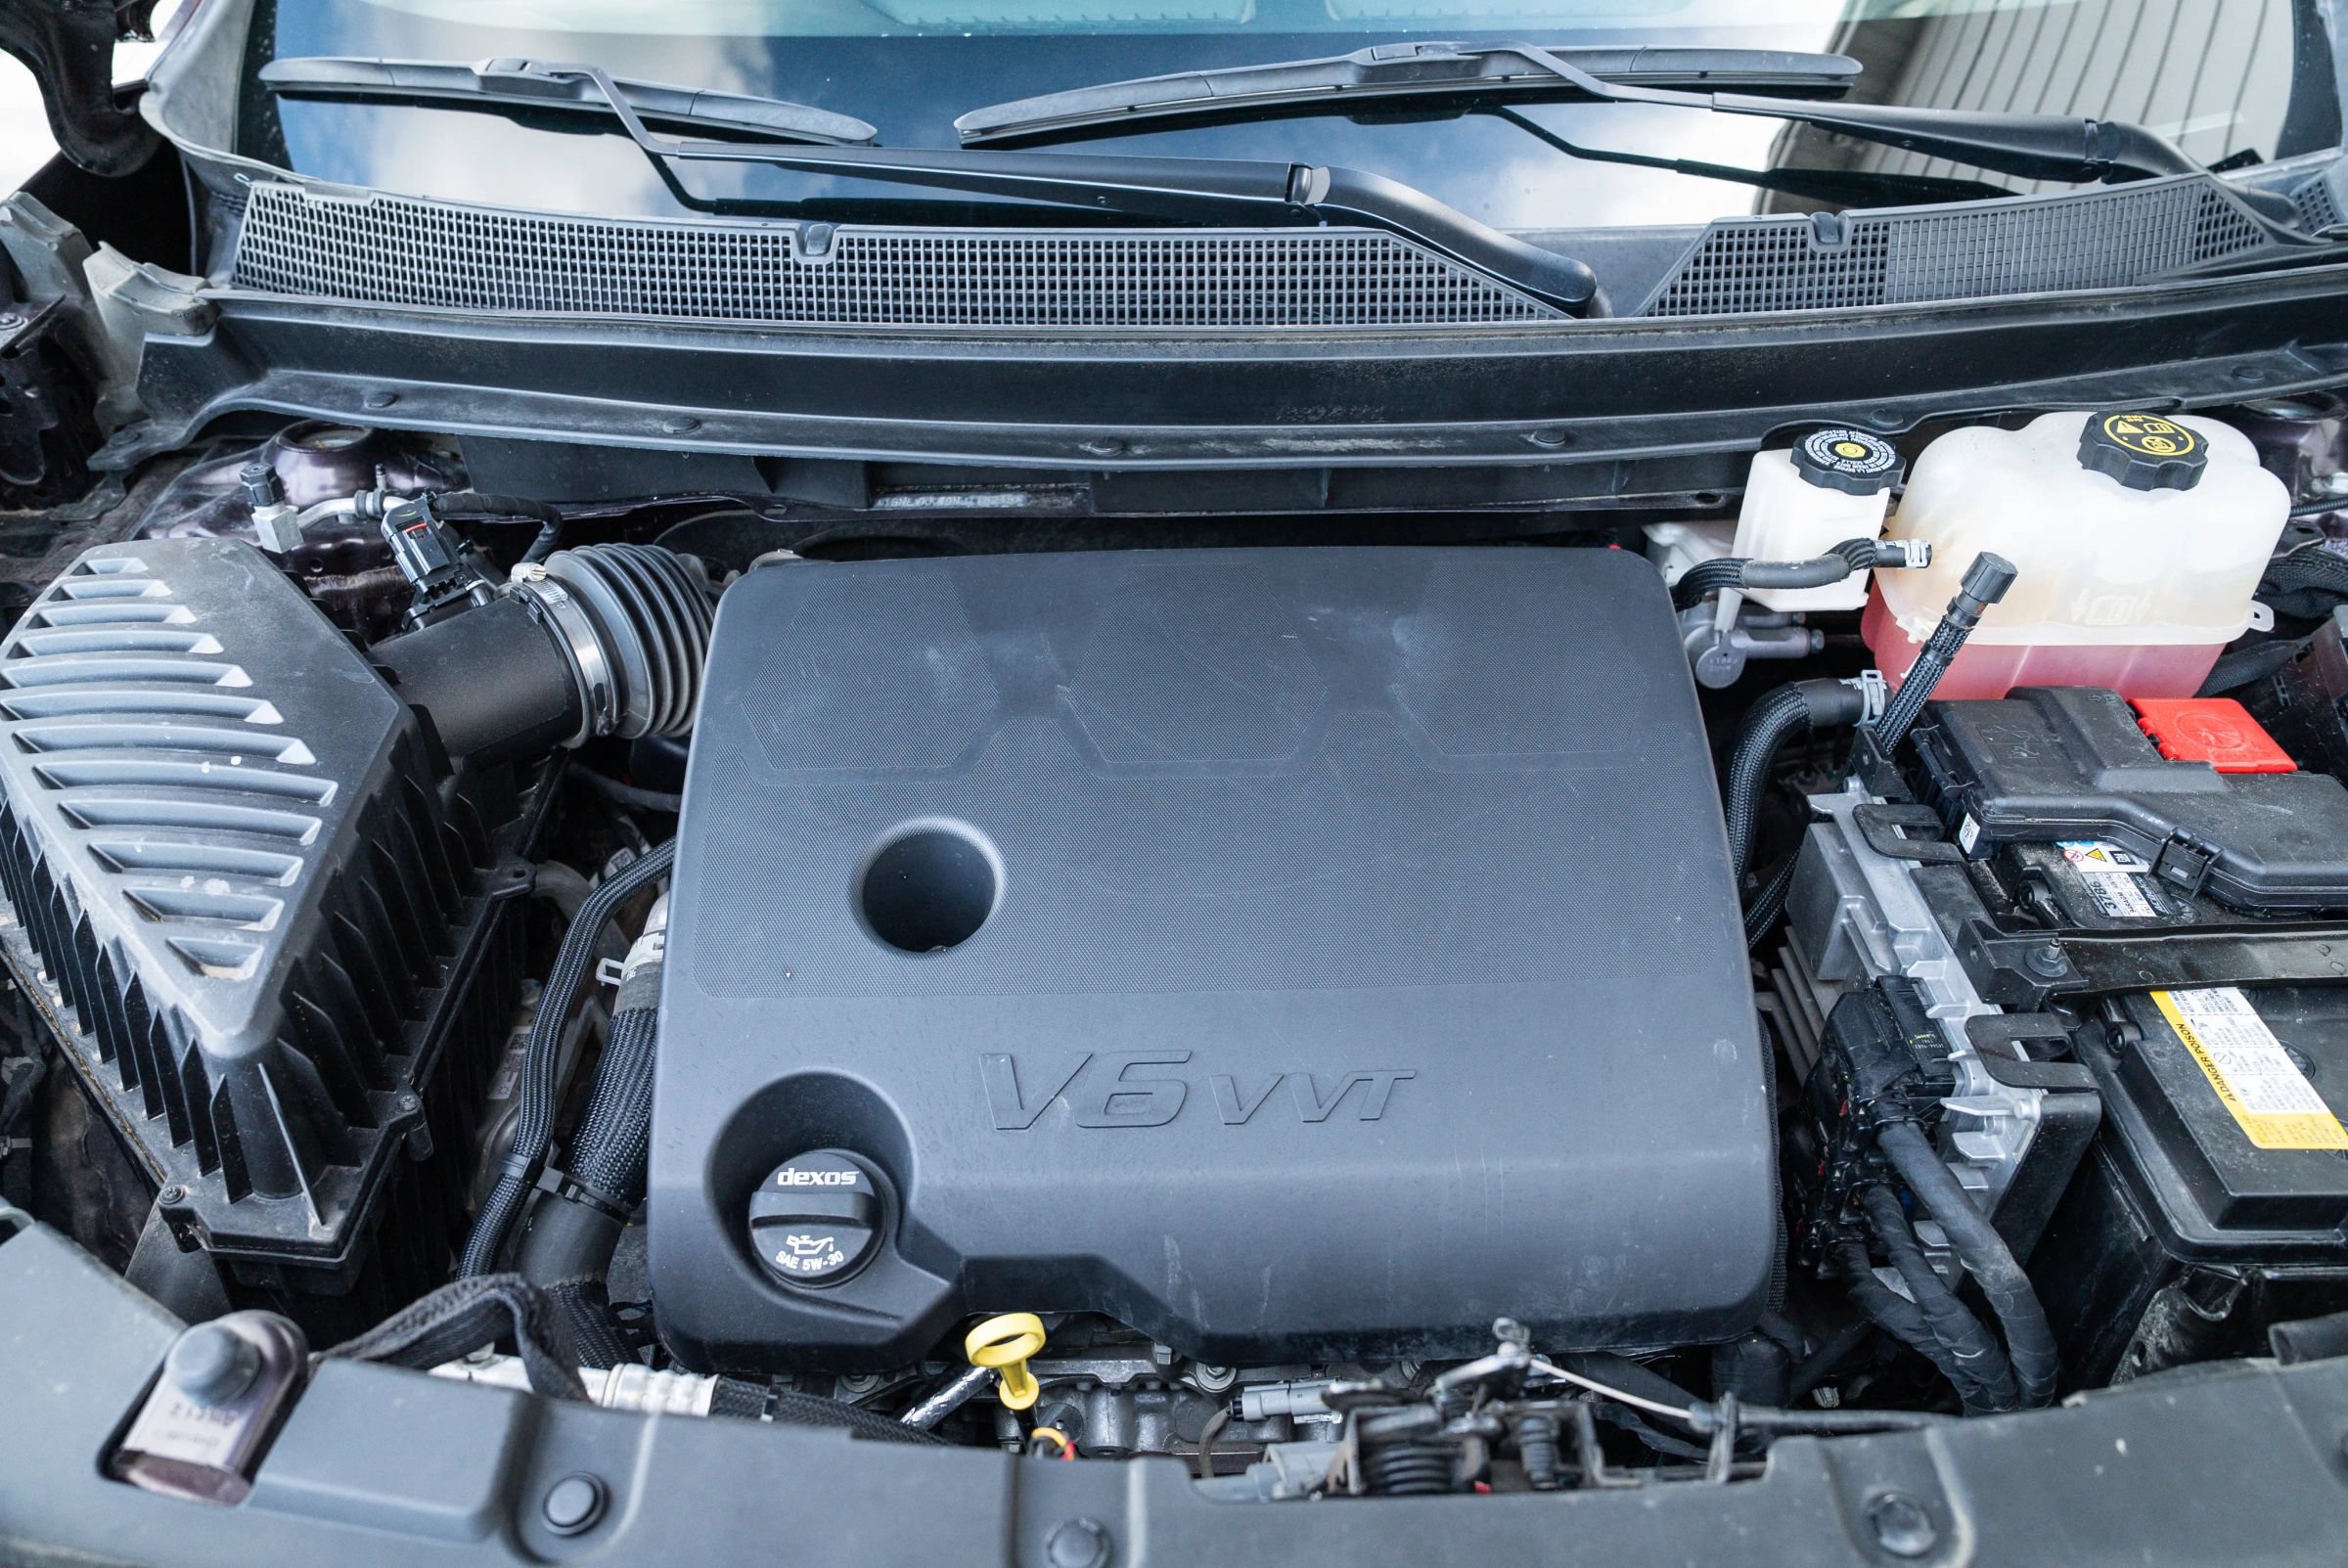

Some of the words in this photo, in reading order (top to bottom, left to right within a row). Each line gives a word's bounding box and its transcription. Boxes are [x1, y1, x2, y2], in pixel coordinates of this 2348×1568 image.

[2090, 880, 2117, 910] 3786
[2176, 1023, 2203, 1054] POISON
[978, 1050, 1193, 1131] V6
[1209, 1069, 1417, 1126] VVT
[2200, 1055, 2232, 1097] DANGER
[777, 1167, 860, 1186] dexos
[775, 1250, 800, 1270] SAE
[801, 1250, 844, 1271] 5W-30
